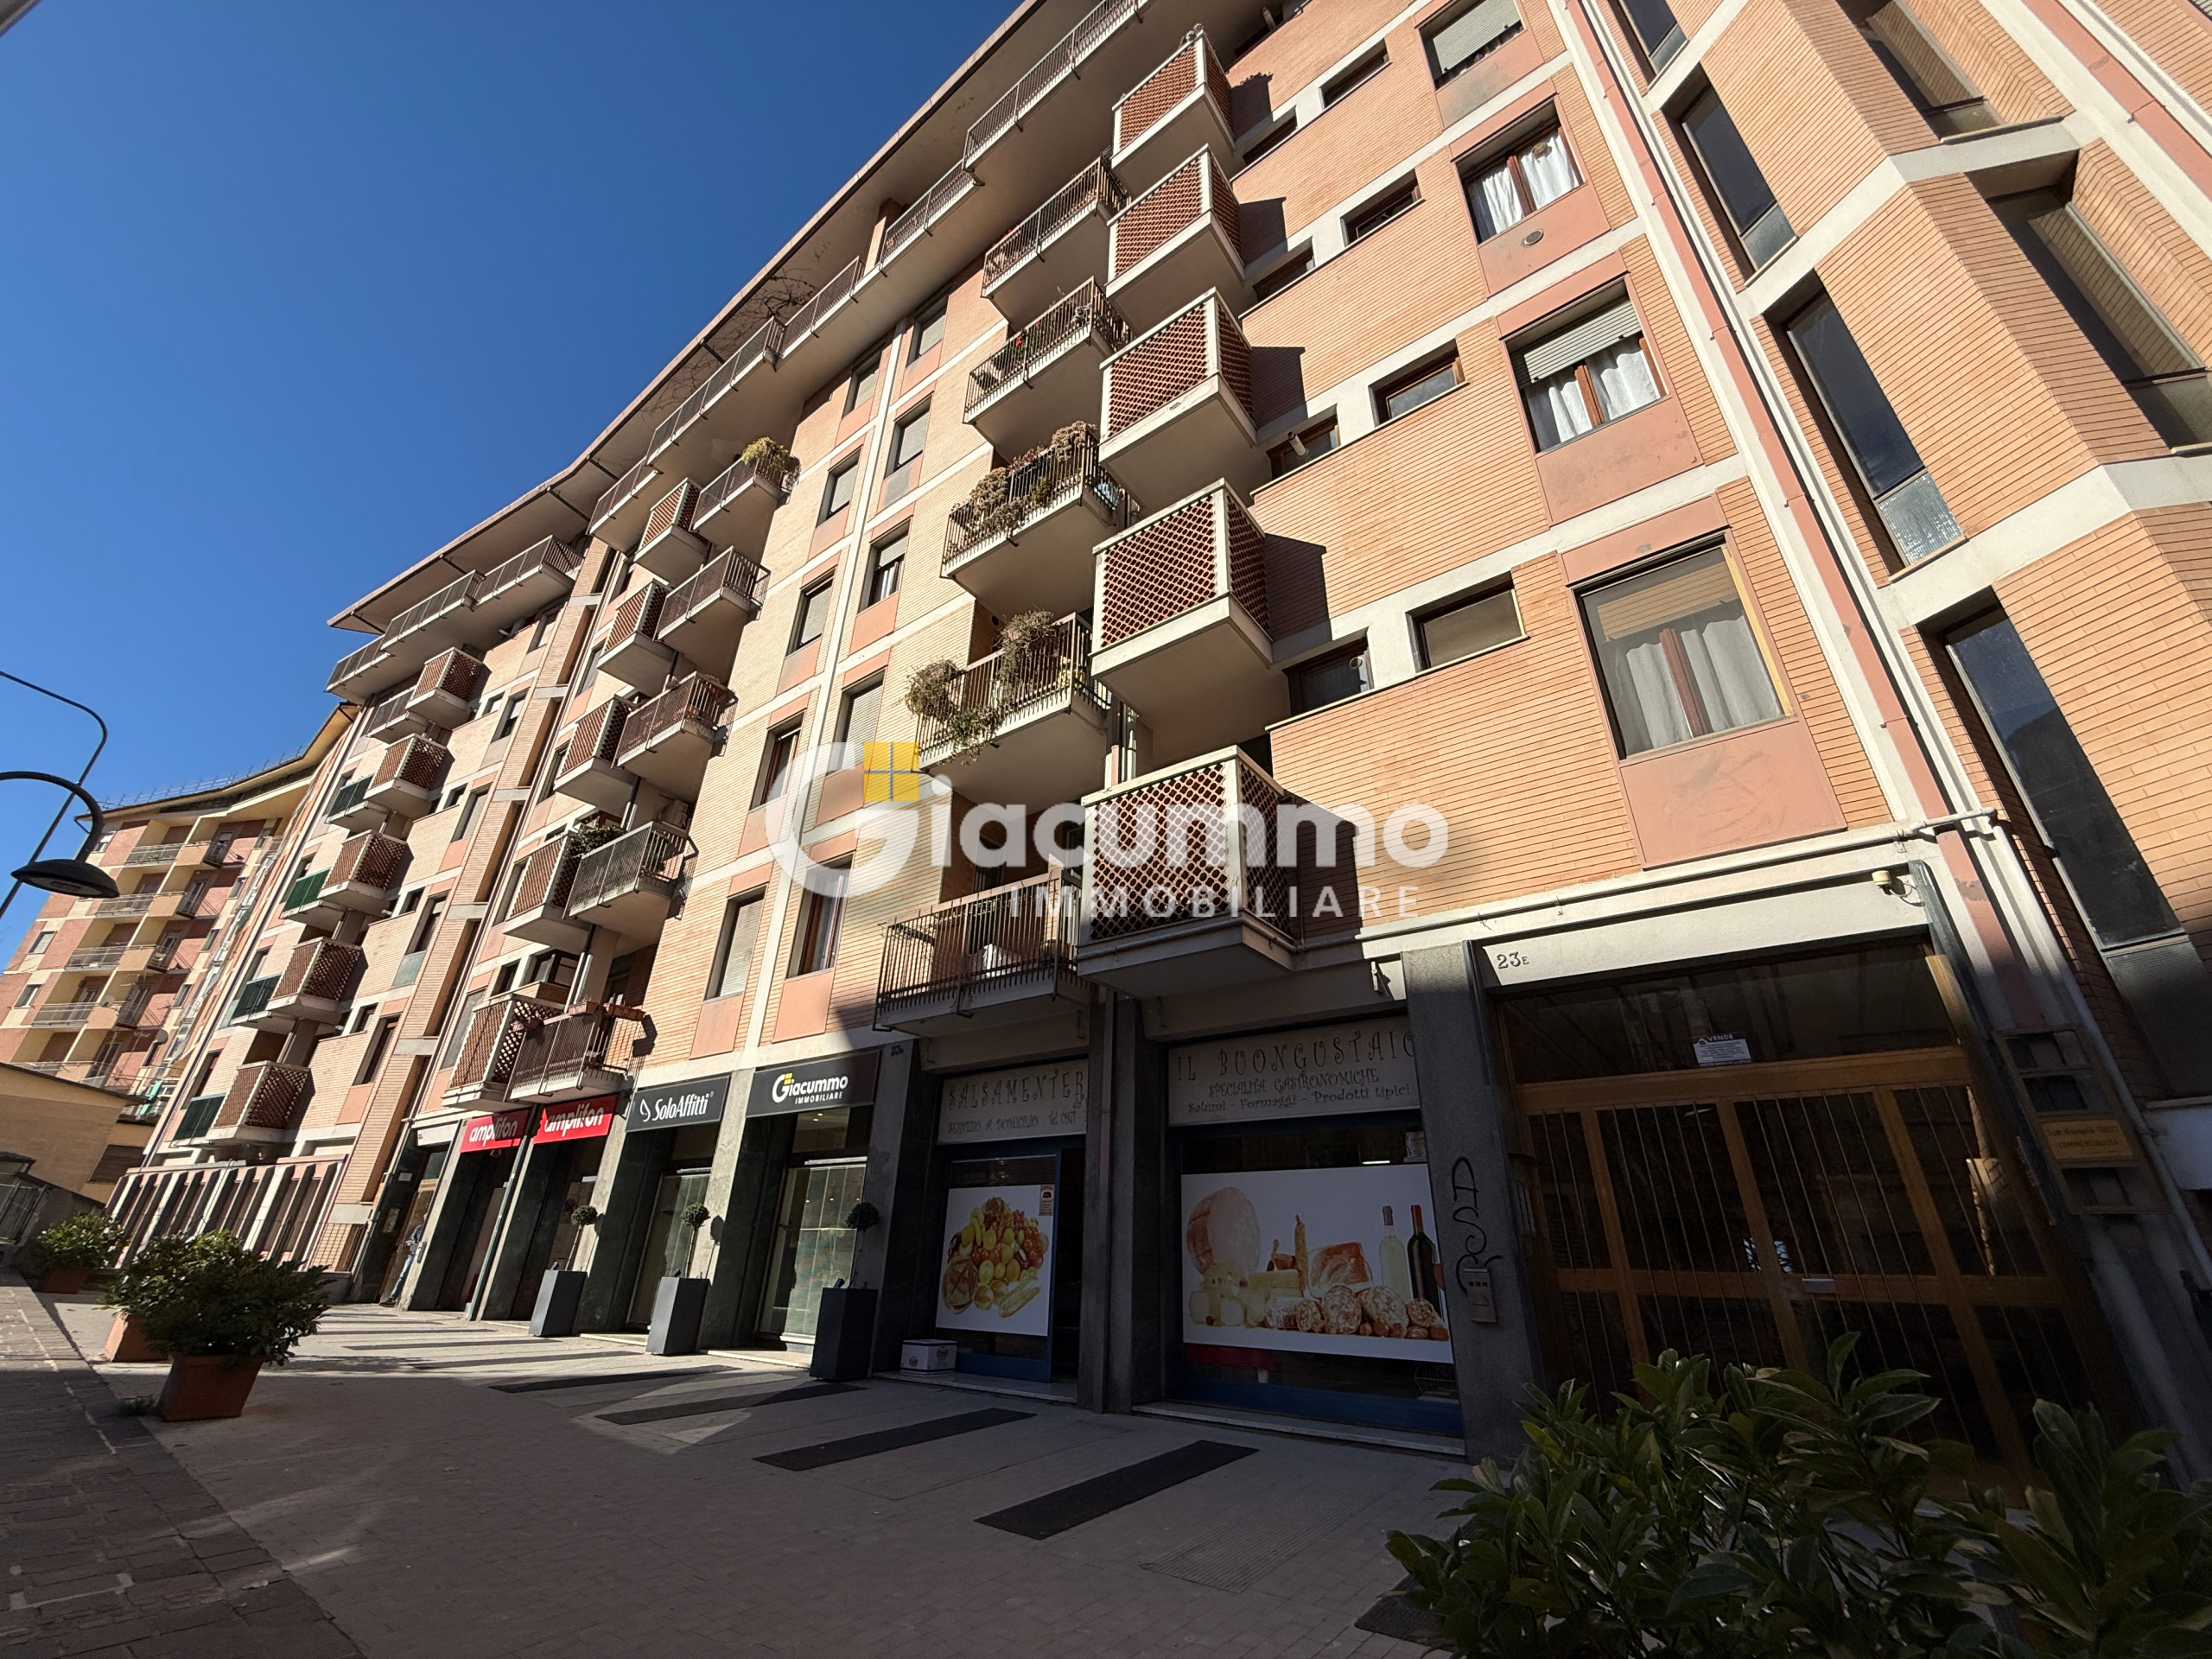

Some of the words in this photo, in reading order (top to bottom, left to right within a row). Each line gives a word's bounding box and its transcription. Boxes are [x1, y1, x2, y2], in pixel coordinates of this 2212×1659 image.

[1496, 951, 1529, 969] 23E
[1707, 1033, 1734, 1042] VENDE
[1177, 1055, 1197, 1081] IL
[1274, 1067, 1380, 1095] GASTRONOMICHE
[772, 1072, 849, 1103] Giacummo
[794, 1091, 843, 1105] IMMOBILIARE
[1188, 1100, 1227, 1114] Salumi
[1240, 1094, 1297, 1109] Formaggi
[1311, 1088, 1370, 1103] Prodotti
[1375, 1084, 1411, 1101] tipici
[468, 1115, 518, 1144] amplifon
[544, 1102, 604, 1136] amplifon
[948, 1119, 982, 1135] SERVIZIO
[986, 1118, 993, 1130] A
[996, 1115, 1039, 1129] DOMICILIO
